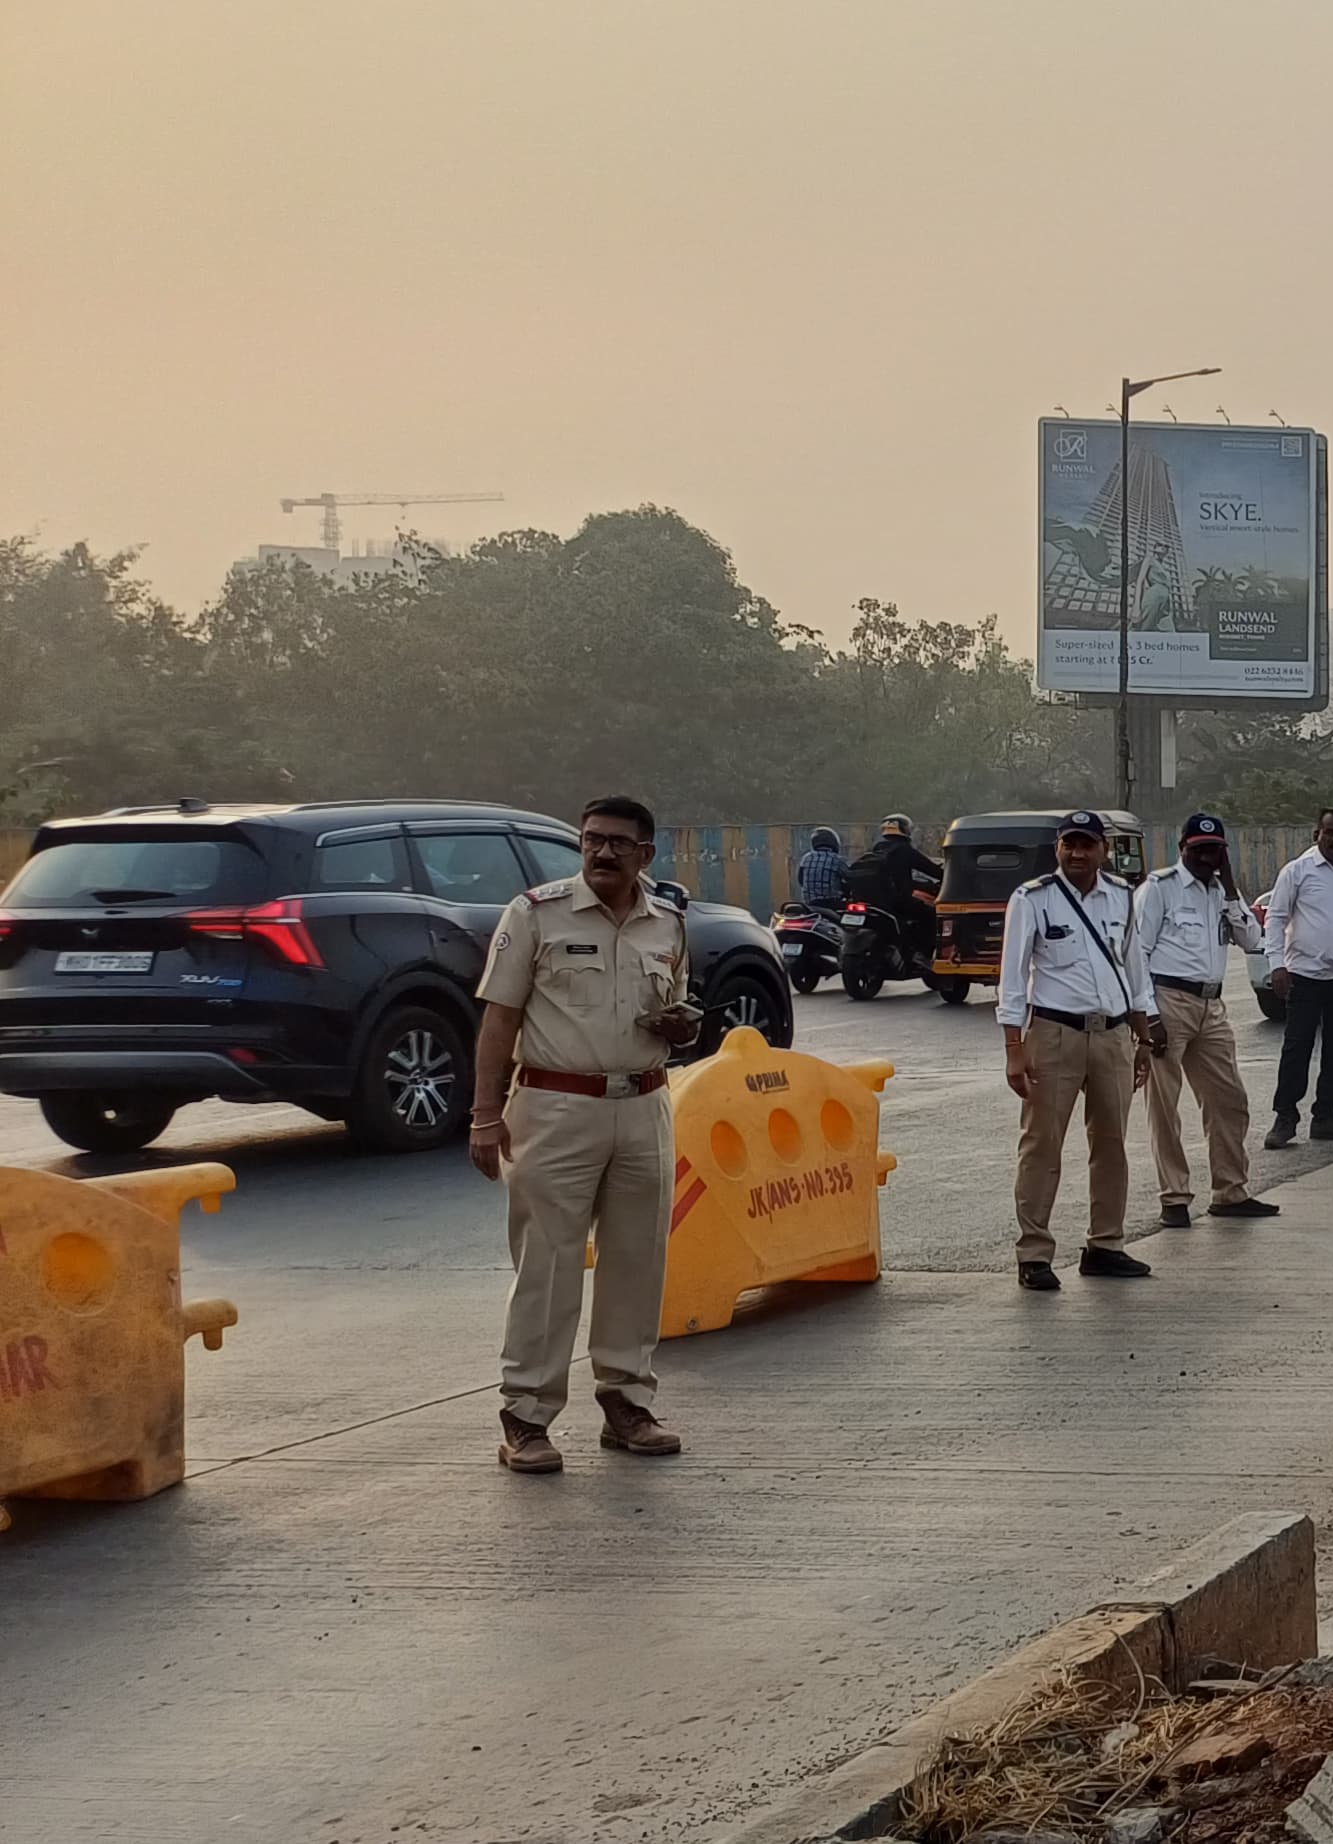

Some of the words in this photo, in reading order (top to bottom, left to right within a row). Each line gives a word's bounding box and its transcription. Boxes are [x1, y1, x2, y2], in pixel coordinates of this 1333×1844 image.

[1052, 463, 1097, 474] RUNWAL
[1199, 501, 1262, 522] SKYE.
[1219, 611, 1278, 623] RUNWAL
[1219, 623, 1275, 634] LANDSEND
[1055, 639, 1114, 650] Super-sized
[1144, 641, 1165, 651] bed
[1166, 641, 1201, 652] homes
[1055, 655, 1095, 665] starting
[1096, 655, 1107, 664] at
[0, 1334, 50, 1397] AR
